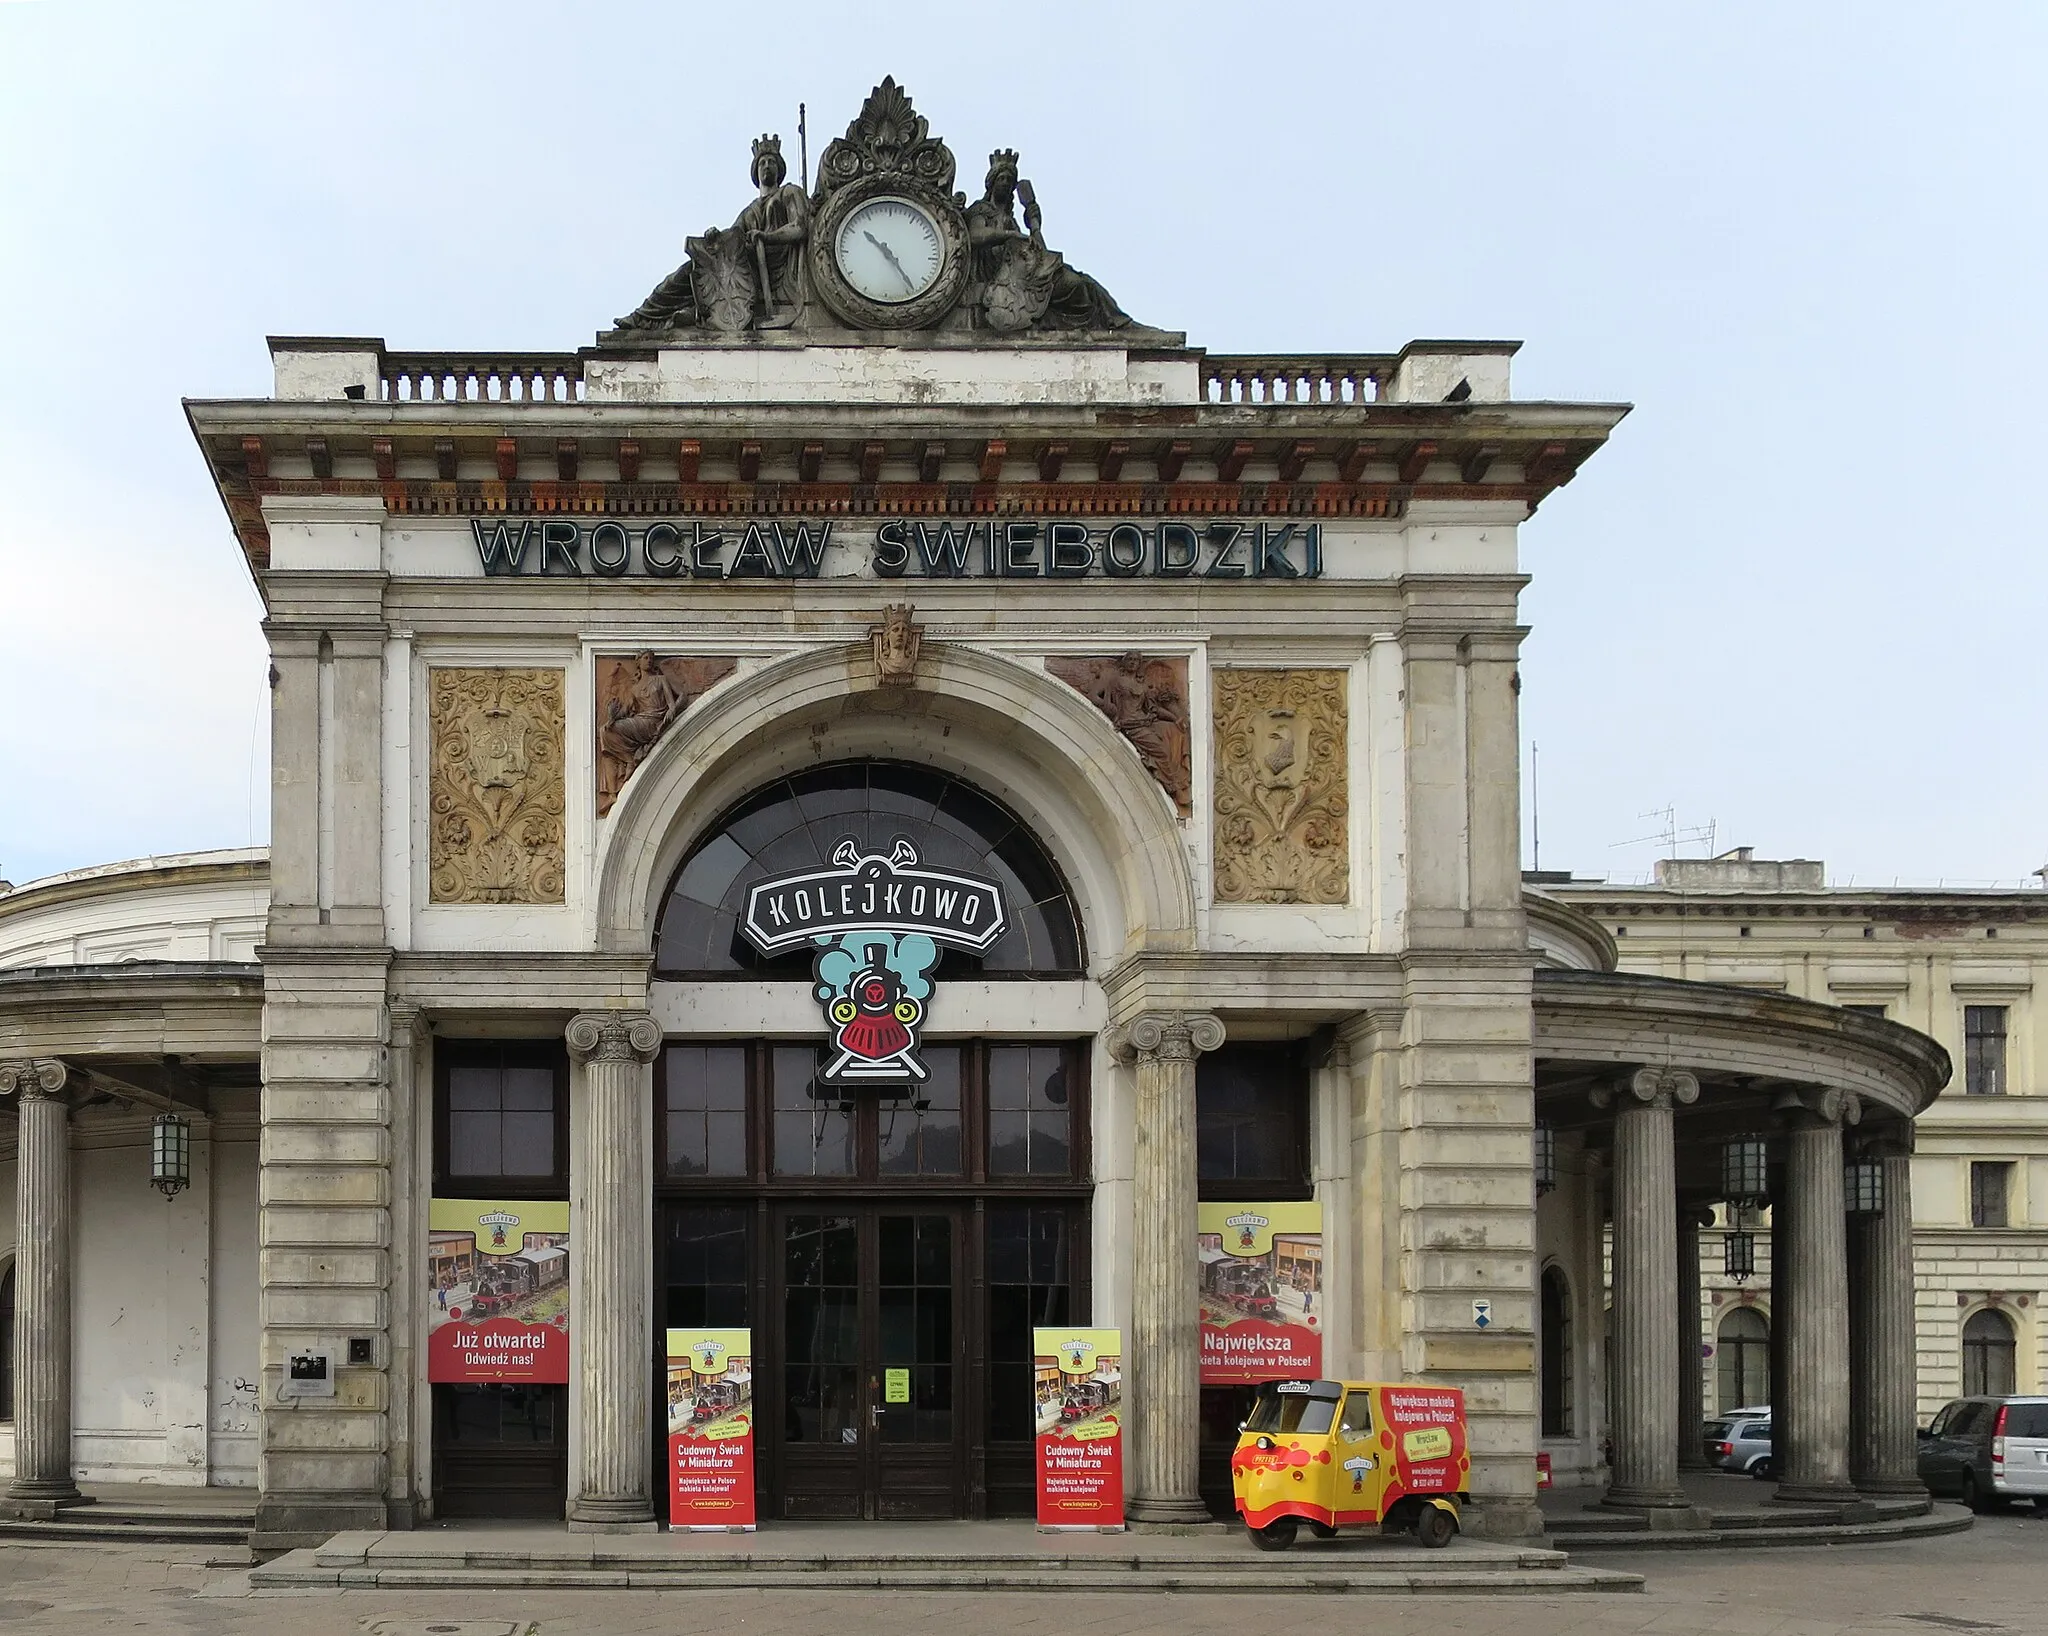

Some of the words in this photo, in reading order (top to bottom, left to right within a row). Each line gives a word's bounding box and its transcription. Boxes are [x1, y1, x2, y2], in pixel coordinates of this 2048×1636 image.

[471, 519, 833, 577] WROCŁAW
[872, 519, 1322, 578] ŚWIEBODZKI
[769, 883, 980, 926] KOLEJKOWO
[452, 1331, 478, 1349] Już
[484, 1331, 546, 1349] otwarte!
[1204, 1332, 1292, 1354] Największa
[465, 1352, 509, 1365] Odwiedź
[512, 1353, 534, 1365] nas!
[1224, 1355, 1265, 1368] kolejowa
[1267, 1357, 1275, 1366] w
[1278, 1355, 1311, 1367] Polsce!
[678, 1444, 716, 1458] Cudowny
[719, 1442, 744, 1456] Świat
[1045, 1444, 1085, 1458] Cudowny
[1087, 1442, 1113, 1456] Świat
[678, 1458, 686, 1468] w
[688, 1456, 734, 1468] Miniaturze
[1045, 1459, 1054, 1468] w
[1056, 1457, 1102, 1468] Miniaturze
[717, 1477, 736, 1485] Polsce
